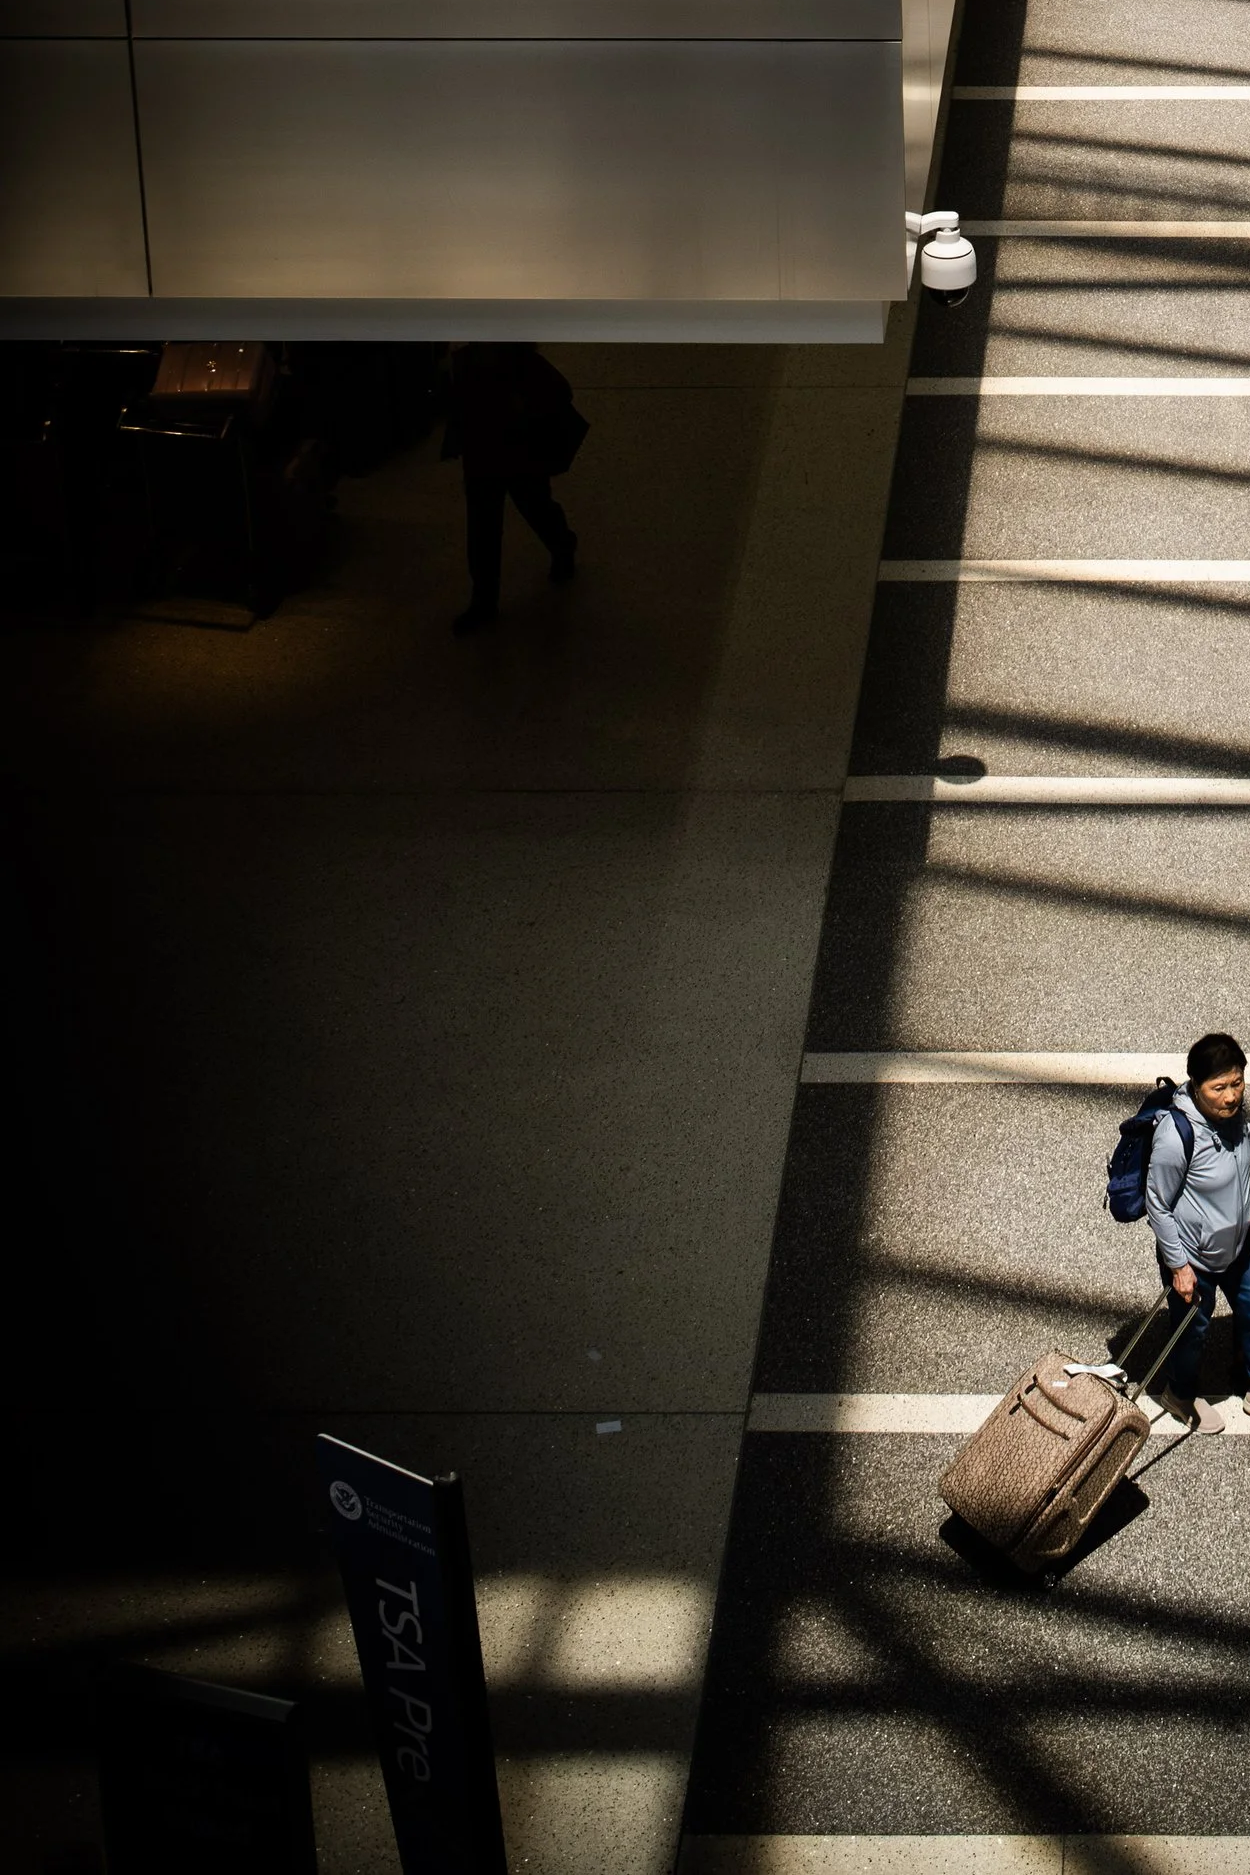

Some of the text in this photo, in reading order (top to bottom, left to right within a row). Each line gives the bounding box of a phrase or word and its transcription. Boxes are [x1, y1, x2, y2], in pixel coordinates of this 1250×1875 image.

[364, 1495, 432, 1534] Transportation
[368, 1518, 437, 1557] Administration
[375, 1577, 433, 1782] TSA Pre
